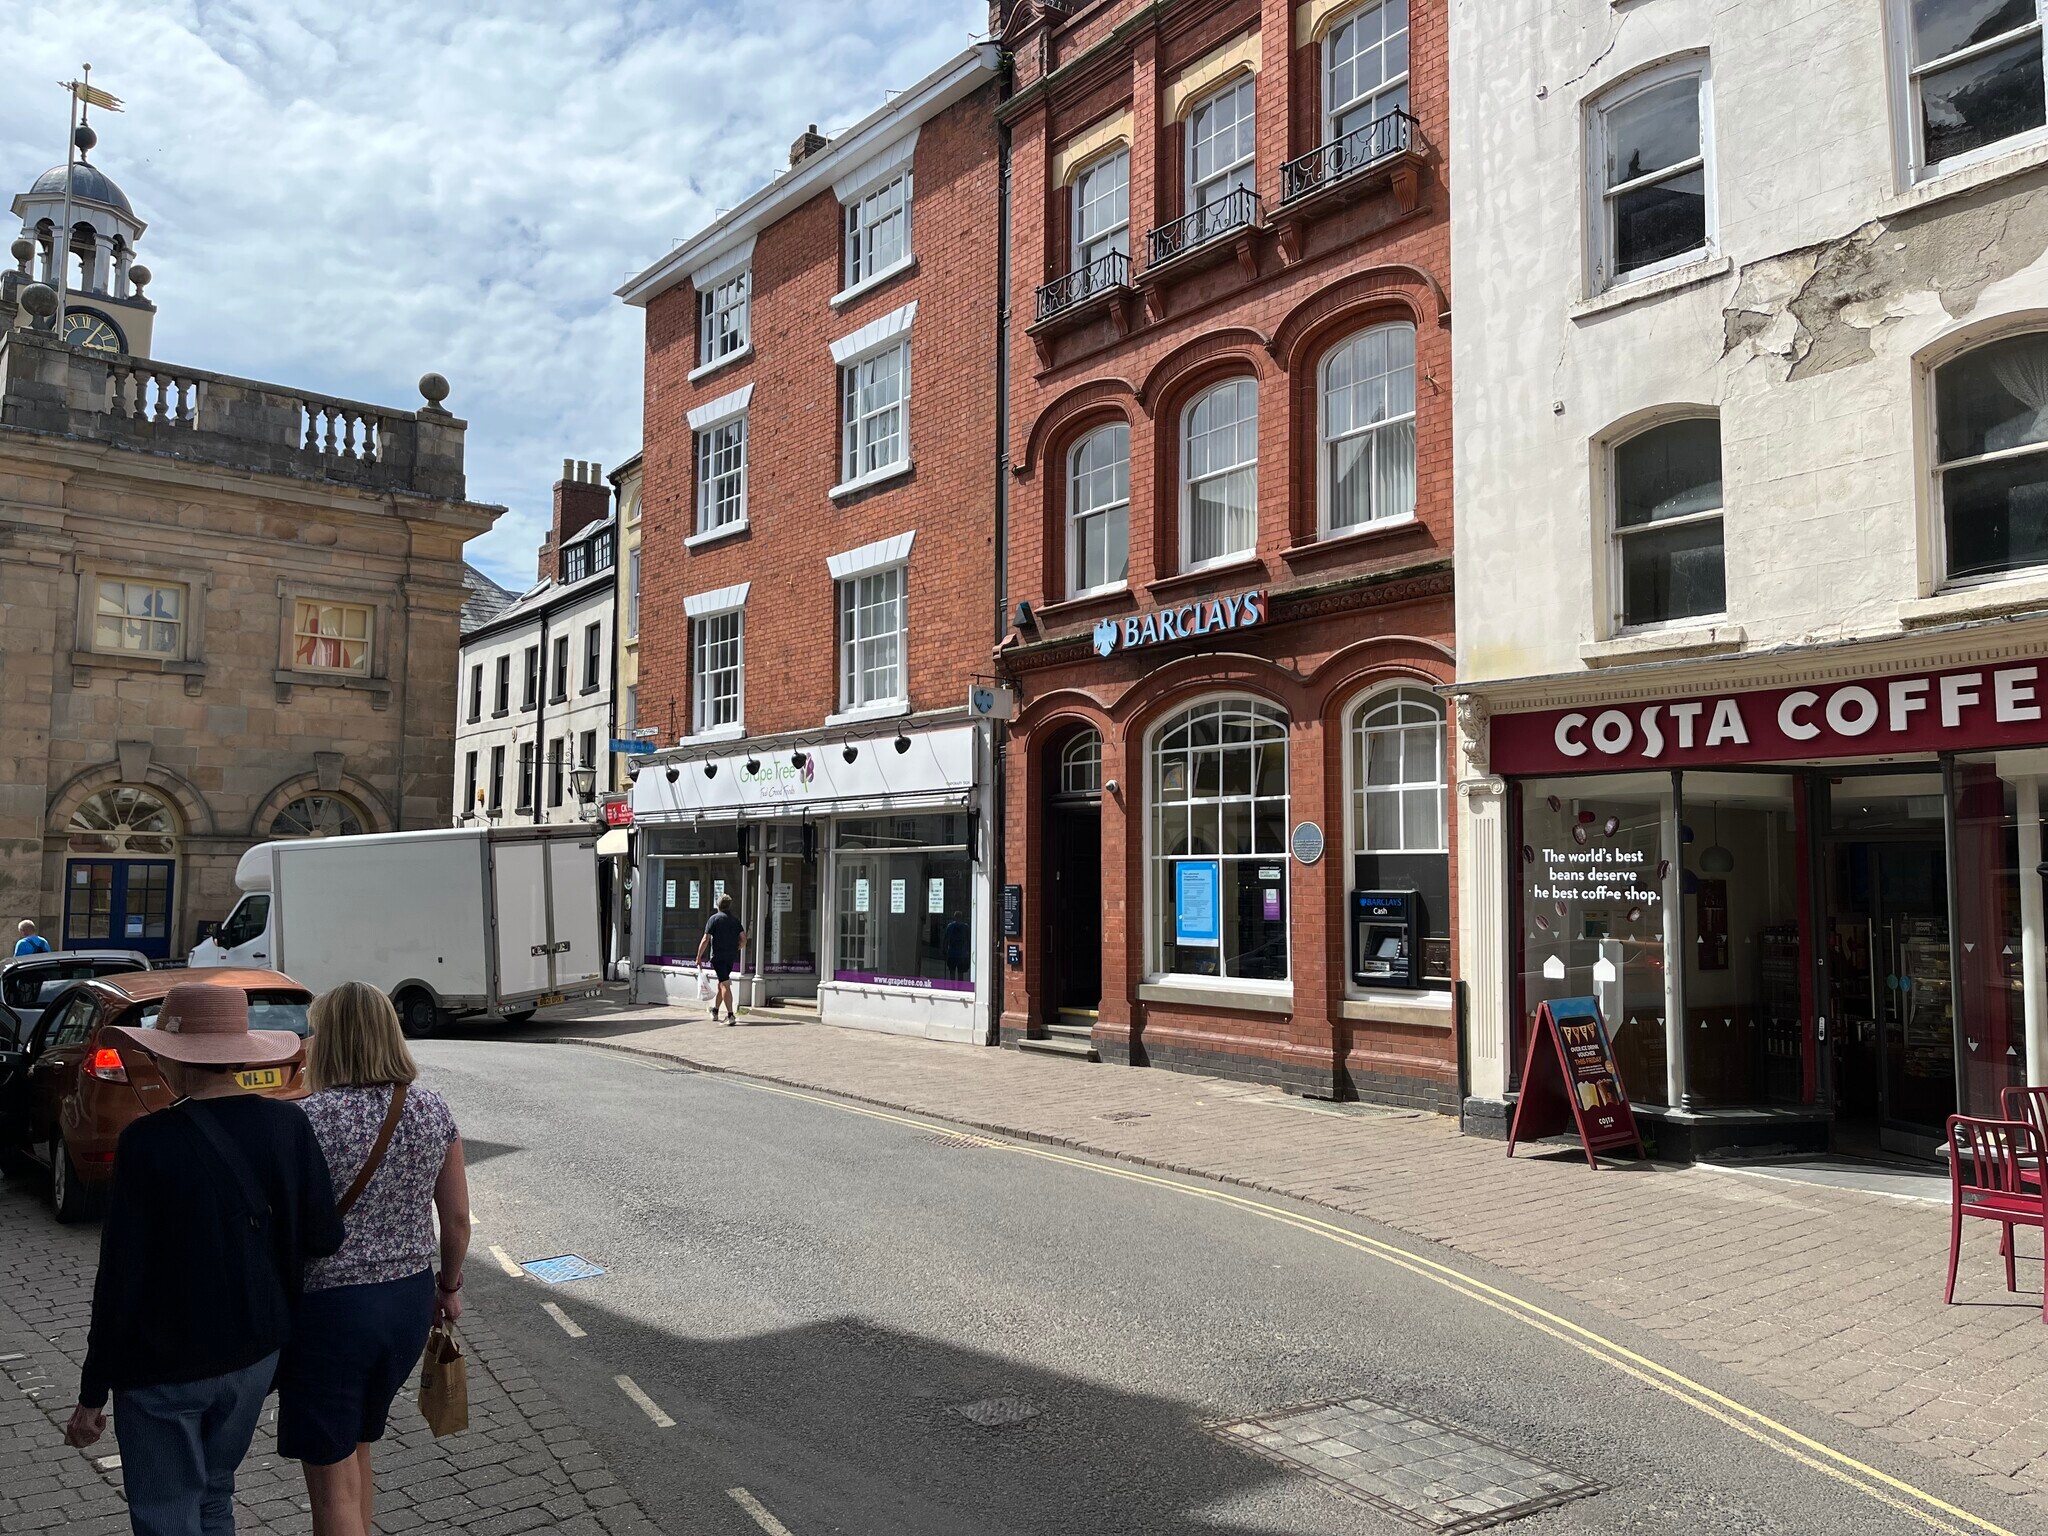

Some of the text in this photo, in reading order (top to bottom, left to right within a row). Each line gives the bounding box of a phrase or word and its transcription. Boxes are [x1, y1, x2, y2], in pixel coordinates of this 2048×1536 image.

[1123, 590, 1261, 649] BARCLAYS
[1553, 698, 1750, 759] COSTA
[774, 761, 796, 780] Tree
[769, 786, 782, 798] Good
[1542, 848, 1644, 863] The world's best
[1549, 867, 1637, 881] beans deserve
[1529, 884, 1661, 905] he best coffee shop.
[1366, 899, 1402, 907] BARCLAYS
[1373, 907, 1388, 915] Cash
[873, 976, 932, 988] www.grapetree.co.uk
[1577, 1050, 1596, 1058] VOUCHER
[242, 1070, 275, 1087] WLD
[1598, 1116, 1615, 1125] COSTA
